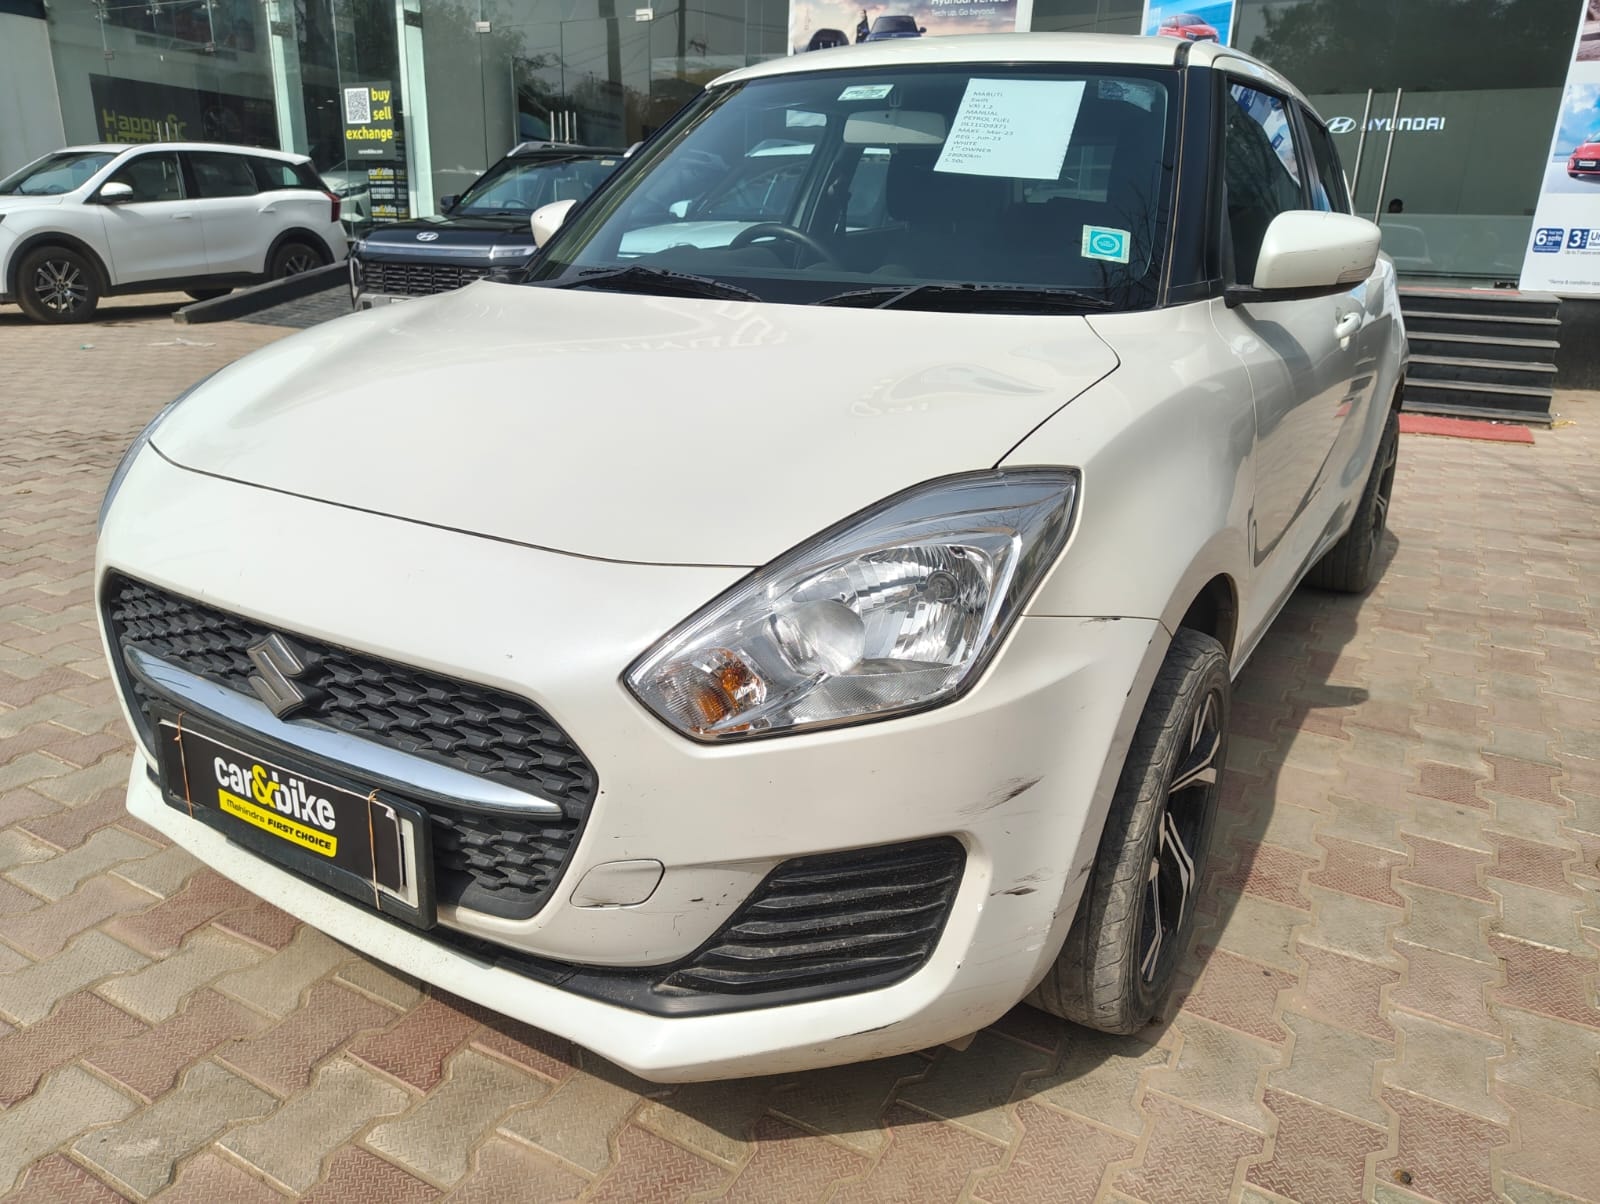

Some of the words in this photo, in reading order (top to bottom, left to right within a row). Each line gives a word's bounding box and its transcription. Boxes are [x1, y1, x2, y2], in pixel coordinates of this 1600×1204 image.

[370, 87, 391, 104] buy
[373, 106, 392, 120] sell
[346, 126, 393, 142] exchange
[1536, 229, 1548, 246] 6
[1569, 230, 1582, 247] 3
[214, 757, 336, 830] car&bike
[267, 818, 295, 835] FIRST
[295, 829, 332, 850] CHOICE
